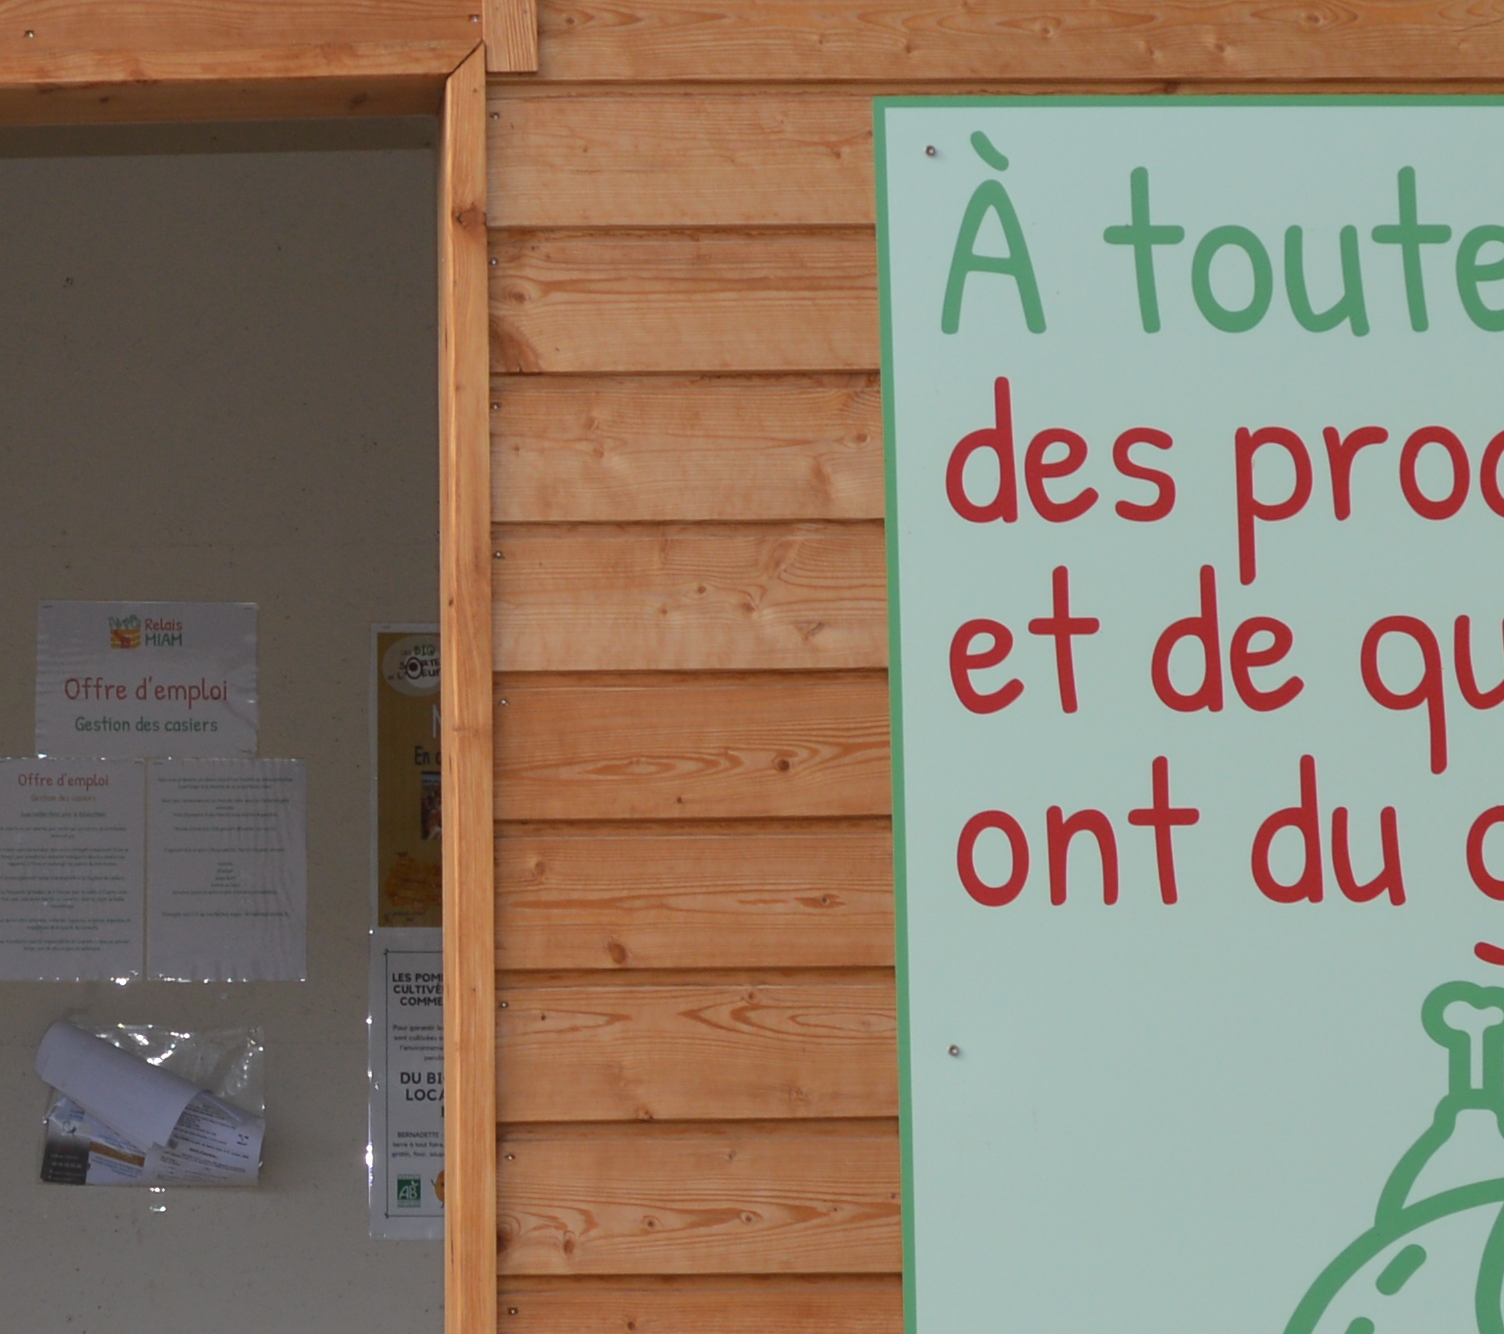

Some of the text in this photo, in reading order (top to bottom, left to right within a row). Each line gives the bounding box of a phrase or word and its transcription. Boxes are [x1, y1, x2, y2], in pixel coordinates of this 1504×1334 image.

[941, 131, 1046, 334] À
[946, 377, 1176, 523] des
[145, 617, 183, 631] Relais
[144, 632, 183, 647] MIAM
[949, 566, 1100, 714] et
[1151, 565, 1304, 712] de
[64, 676, 228, 710] Offre d'emploi
[74, 715, 219, 733] Gestion des casiers
[17, 772, 109, 792] Offre d'emploi
[957, 756, 1200, 907] ont
[1251, 754, 1406, 906] du
[392, 972, 412, 983] LES
[393, 983, 443, 995] CULTIVÉ
[409, 1025, 435, 1033] garantir
[408, 1034, 437, 1042] cultivées
[400, 1071, 444, 1085] DU BI
